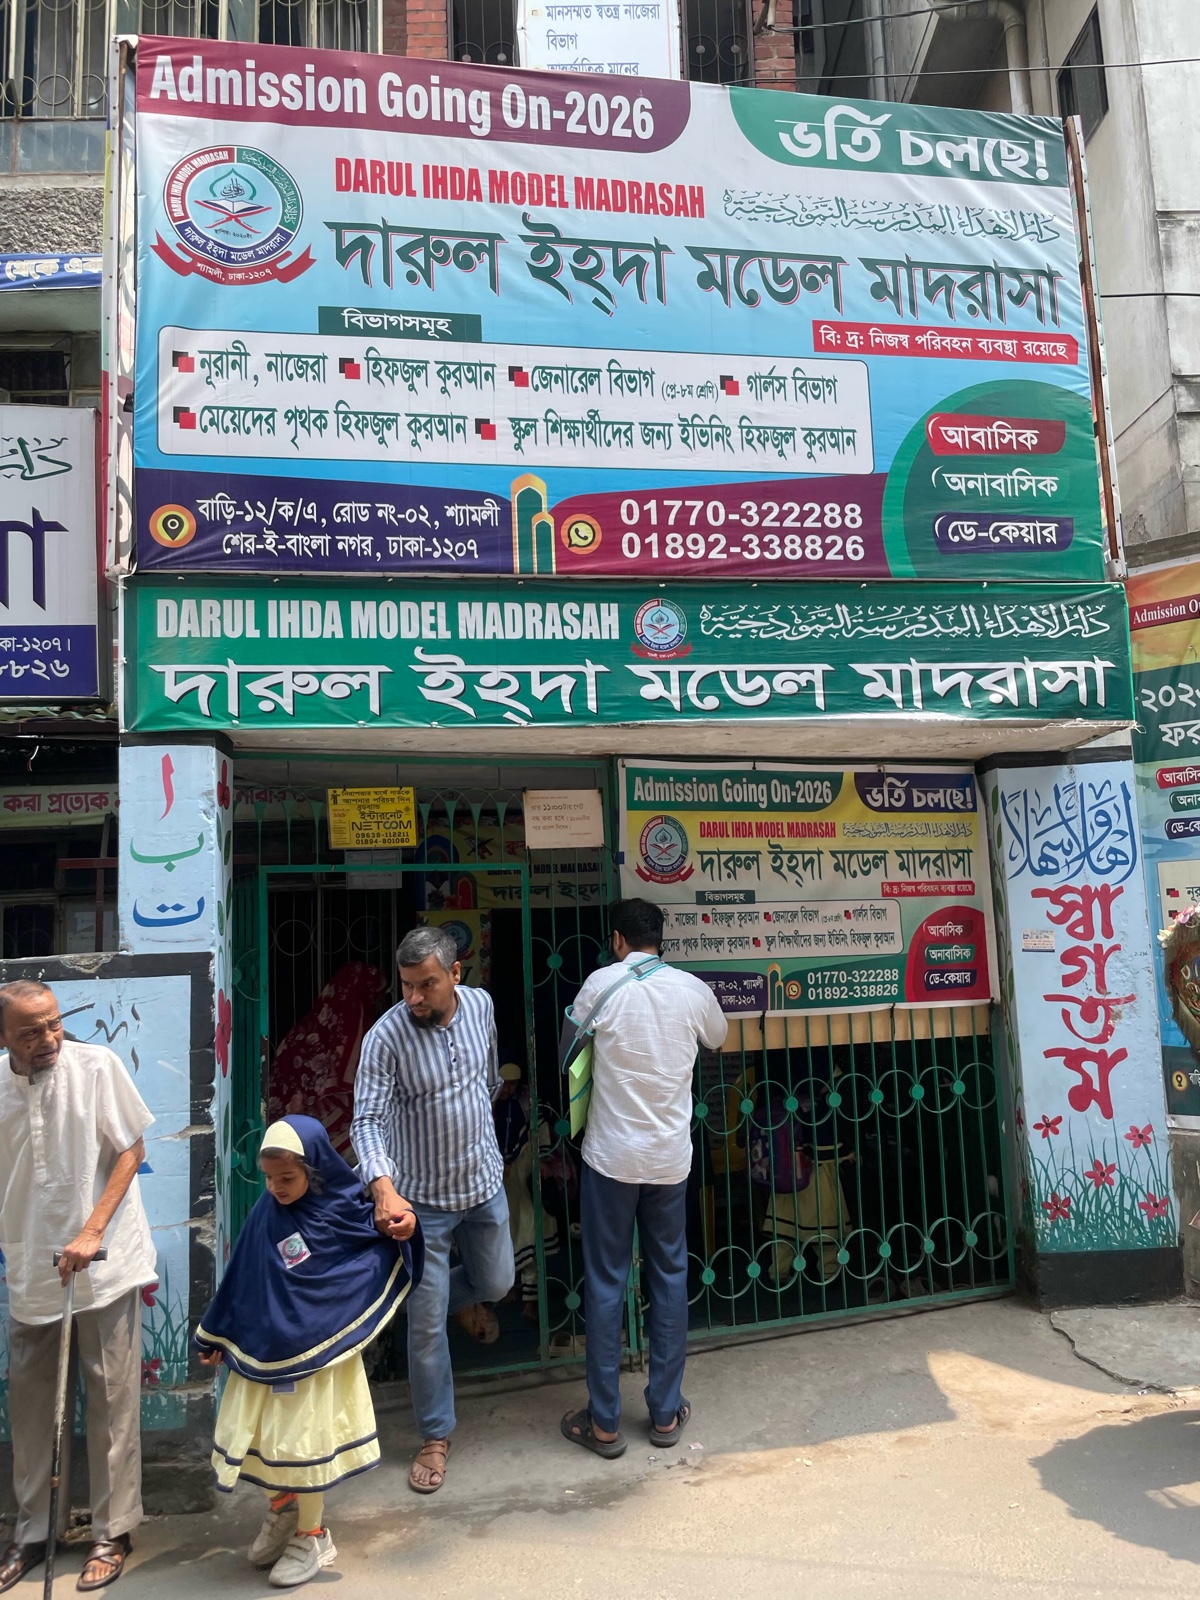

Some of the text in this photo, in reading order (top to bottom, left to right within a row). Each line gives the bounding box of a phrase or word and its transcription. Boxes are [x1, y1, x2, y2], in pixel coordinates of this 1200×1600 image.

[623, 3, 660, 20] নাজেরা
[546, 29, 578, 50] বিভাগ
[150, 54, 655, 140] Admission Going On-2026
[775, 104, 1049, 181] ভর্তি চলছে!
[191, 150, 229, 170] MADRASAH
[335, 157, 417, 199] DARUL
[423, 163, 483, 204] IHDA
[489, 169, 569, 210] MODEL
[574, 176, 705, 219] MADRASAH
[230, 250, 256, 262] মডেল
[323, 217, 507, 297] দারুল
[684, 243, 848, 316] মডেল
[857, 253, 1066, 328] মাদরাসা
[341, 308, 453, 339] বিভাগসমূহ
[867, 327, 910, 349] নিজস্ব
[915, 330, 972, 353] পরিবহন
[978, 337, 1017, 358] ব্যবস্থা
[1022, 339, 1070, 360] রয়েছে
[265, 351, 329, 384] নাজেরা
[364, 346, 430, 395] হিফজুল
[434, 360, 497, 400] কুরআন
[531, 364, 602, 395] জেনারেল
[607, 359, 655, 398] বিভাগ
[747, 365, 787, 402] গার্লস
[791, 367, 838, 404] বিভাগ
[199, 399, 857, 464] মেয়েদের পৃথক হিফজুল কুরআন স্কুল শিক্ষার্থীদের জন্য ইভিনিং হিফজুল কুরআন
[939, 420, 1040, 451] আবাসিক
[943, 468, 1060, 497] অনাবাসিক
[333, 500, 371, 523] রোড
[444, 498, 501, 527] শ্যামলী
[620, 498, 864, 529] 01770-322288
[222, 529, 331, 557] শের-ই-বাংলা
[386, 535, 479, 560] ঢাকা-১২০৭
[621, 532, 865, 561] 01892-338826
[948, 520, 1059, 545] ডে-কেয়ার
[156, 598, 260, 638] DARUL
[267, 600, 345, 639] IHDA
[351, 601, 452, 640] MODEL
[458, 602, 620, 640] MADRASAH
[1133, 603, 1187, 625] Admission
[148, 657, 395, 719] দারুল
[624, 662, 836, 713] মডেল
[848, 655, 1117, 712] মাদরাসা
[3, 793, 42, 813] করা
[47, 791, 110, 815] প্রত্যেক
[633, 776, 833, 809] Admission Going On-2026
[864, 776, 973, 810] ভর্তি চলছে!
[351, 820, 412, 831] NETCOM
[699, 821, 836, 839] DARUL IHDA MODEL MADRASAH
[130, 832, 205, 872] ب
[696, 846, 762, 881] দারুল
[831, 848, 889, 881] মডেল
[894, 846, 974, 880] মাদরাসা
[133, 896, 205, 927] ت
[705, 891, 746, 904] বিভাগসমূহ
[674, 911, 698, 926] নাজেরা
[711, 908, 735, 929] হিফজুল
[737, 910, 760, 930] কুরআন
[801, 906, 819, 923] বিভাগ
[869, 904, 887, 922] বিভাগ
[928, 921, 964, 938] আবাসিক
[700, 932, 725, 955] হিফজুল
[727, 936, 750, 955] কুরআন
[849, 928, 872, 950] হিফজুল
[873, 932, 896, 950] কুরআন
[929, 946, 972, 962] অনাবাসিক
[806, 968, 899, 985] 01770-322288
[807, 984, 899, 1001] 01892-338826
